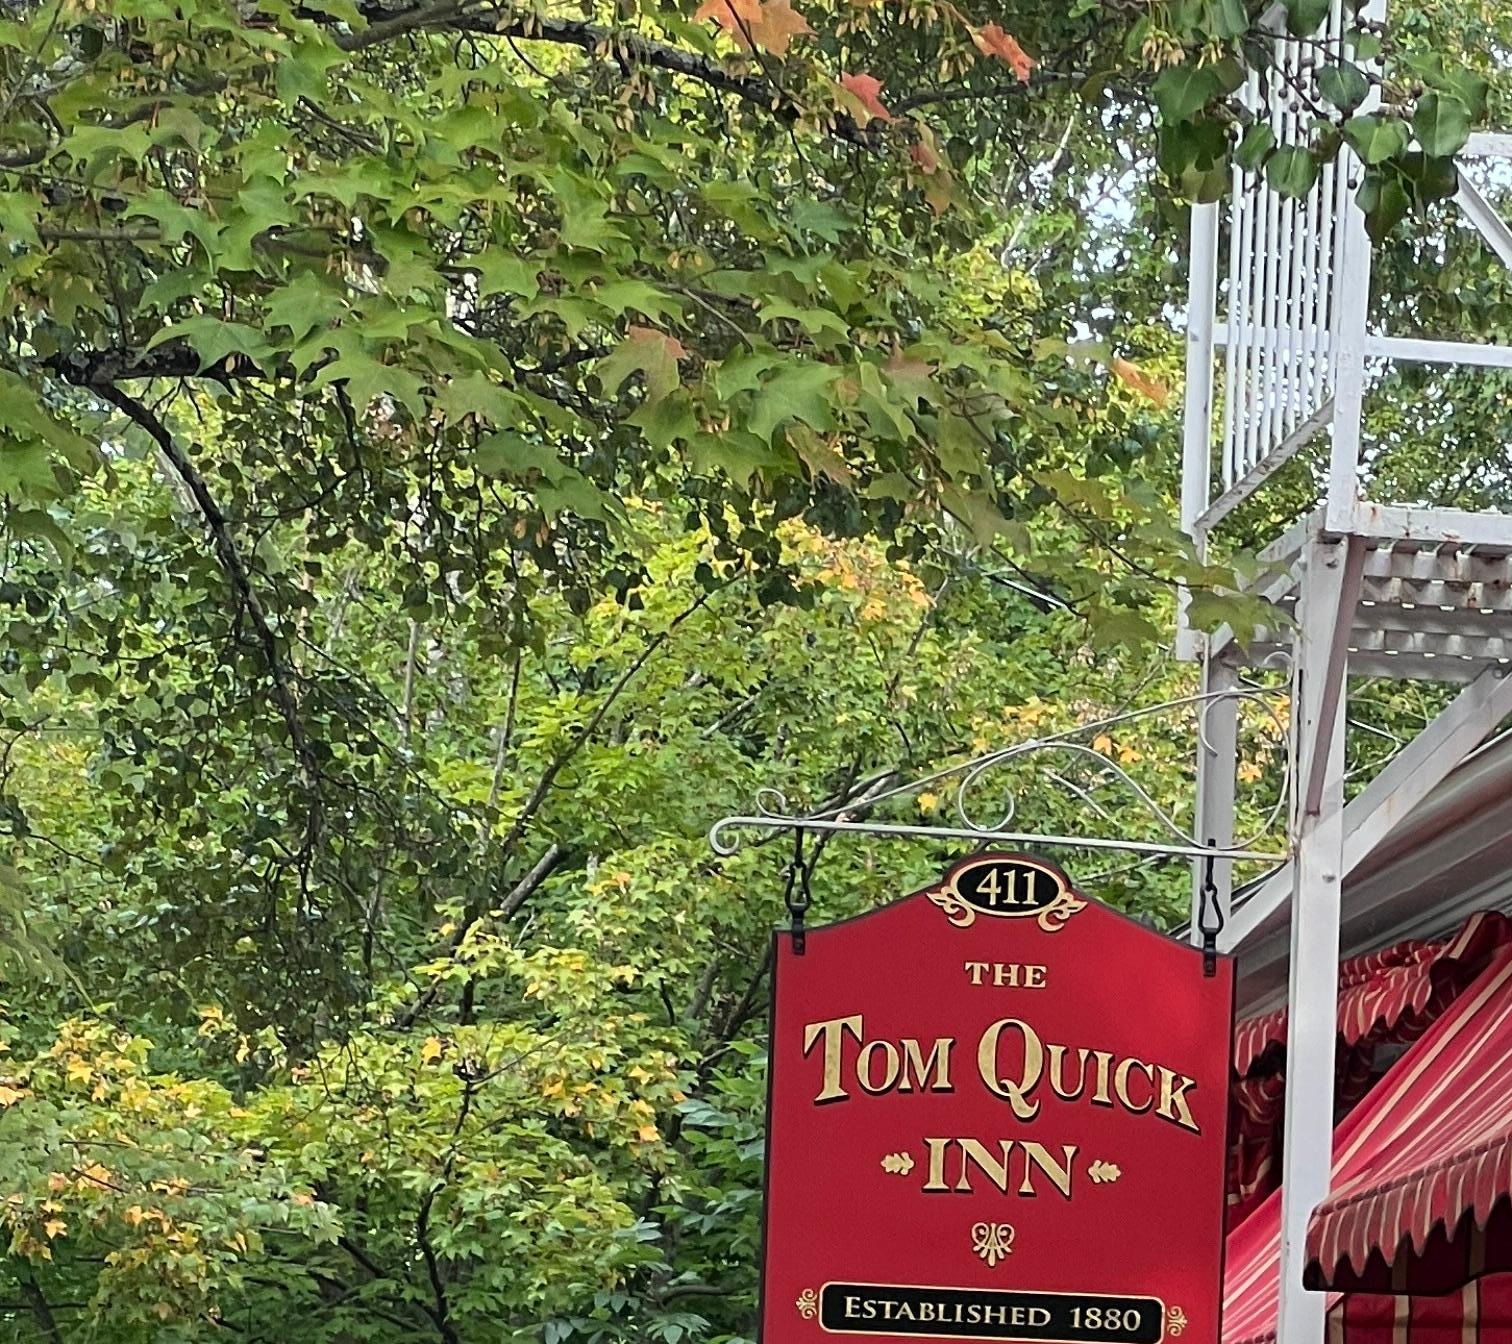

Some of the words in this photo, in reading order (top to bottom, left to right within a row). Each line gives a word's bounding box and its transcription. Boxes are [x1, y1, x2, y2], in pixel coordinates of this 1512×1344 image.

[975, 870, 1039, 906] 411
[963, 960, 1047, 989] THE
[803, 1014, 955, 1103] TOM
[976, 1017, 1201, 1133] QUICK
[920, 1136, 1079, 1199] INN
[843, 1295, 1052, 1327] ESTABLISHED
[1068, 1305, 1142, 1332] 1880
